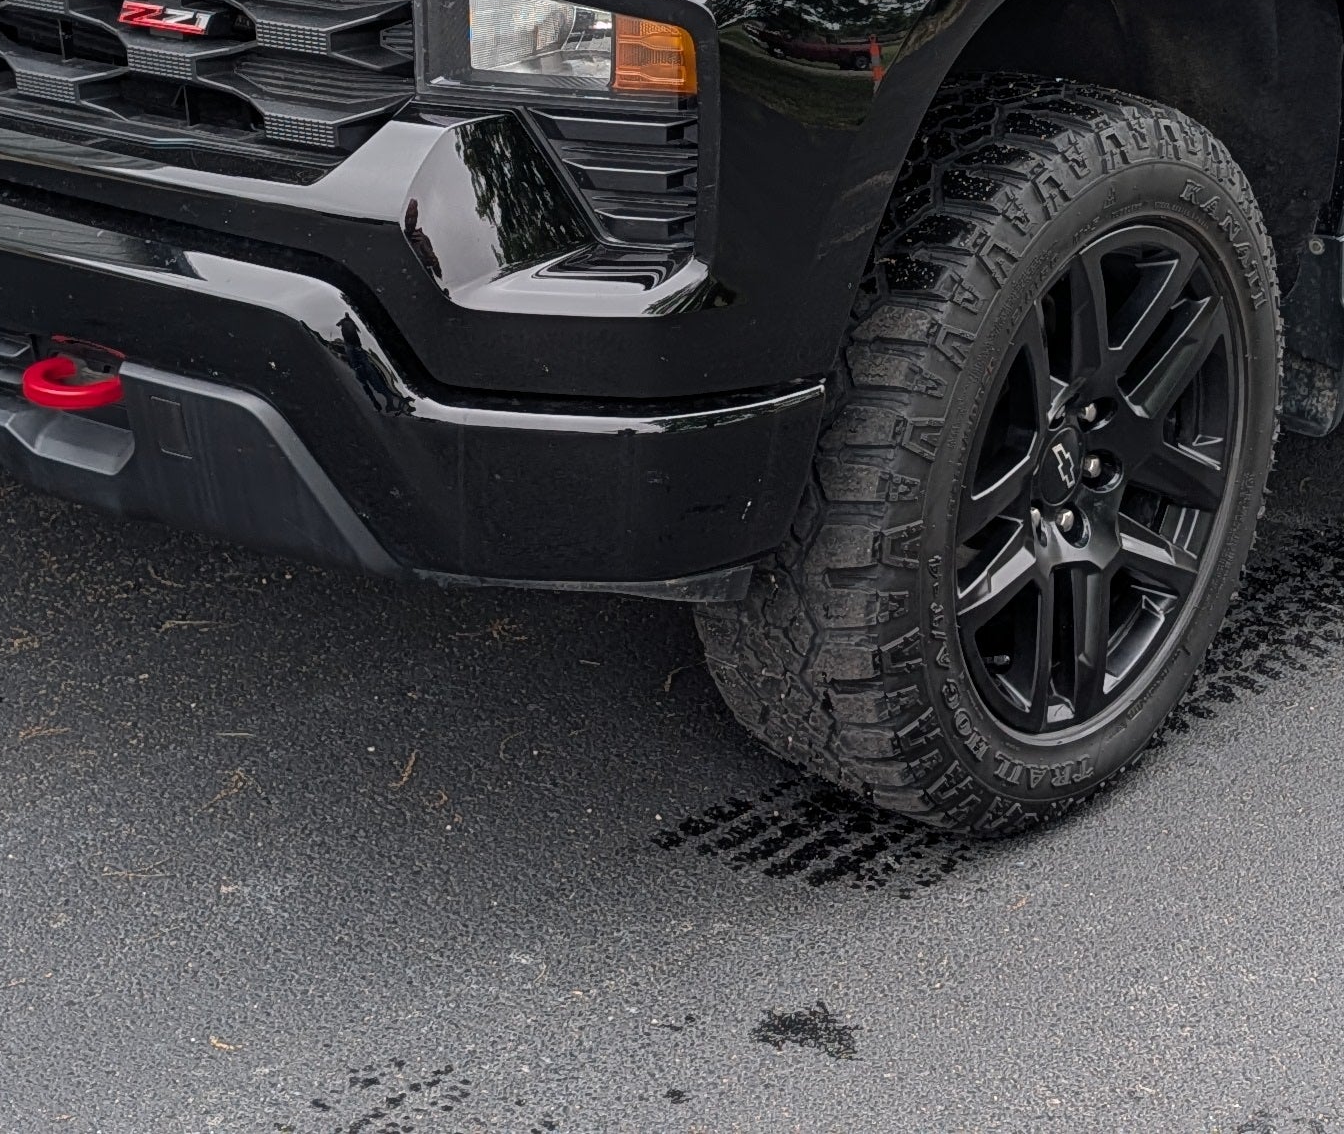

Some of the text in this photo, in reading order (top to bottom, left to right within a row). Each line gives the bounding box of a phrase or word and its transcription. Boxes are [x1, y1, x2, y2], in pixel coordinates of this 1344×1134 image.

[1179, 178, 1267, 310] KANATI
[941, 677, 991, 761] HOG
[993, 750, 1095, 790] TRAIL
